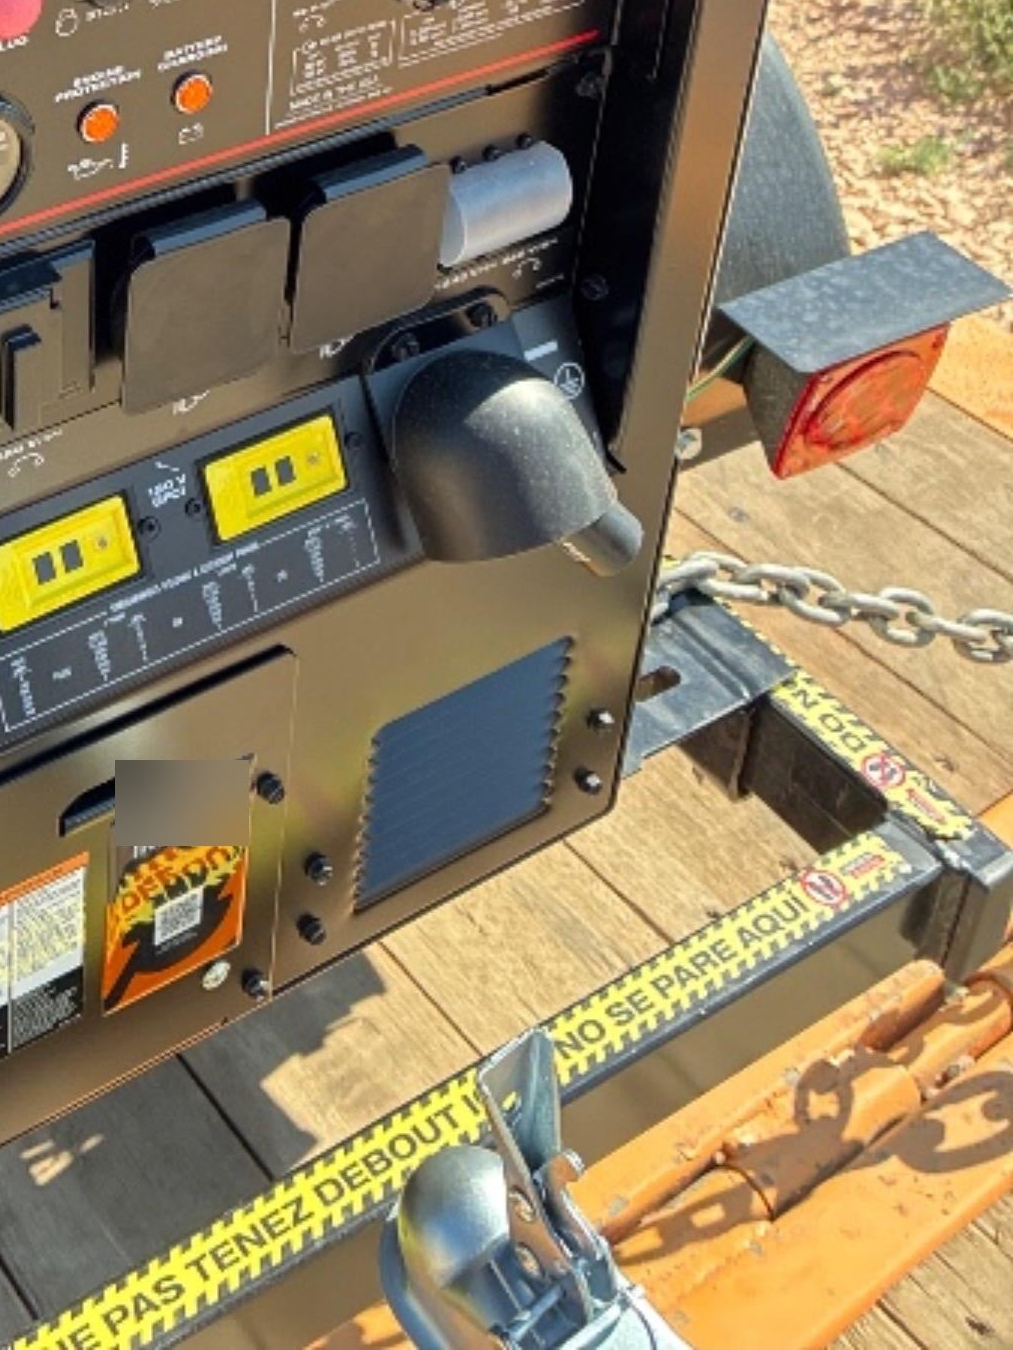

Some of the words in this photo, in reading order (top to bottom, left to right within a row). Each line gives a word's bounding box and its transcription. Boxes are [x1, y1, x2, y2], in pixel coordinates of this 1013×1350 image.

[553, 1018, 606, 1061] NO
[604, 988, 656, 1028] SE
[649, 936, 737, 1000] PARE
[102, 1275, 185, 1333] PAS
[185, 1200, 316, 1285] TENEZ
[313, 1103, 461, 1208] DEBOUT
